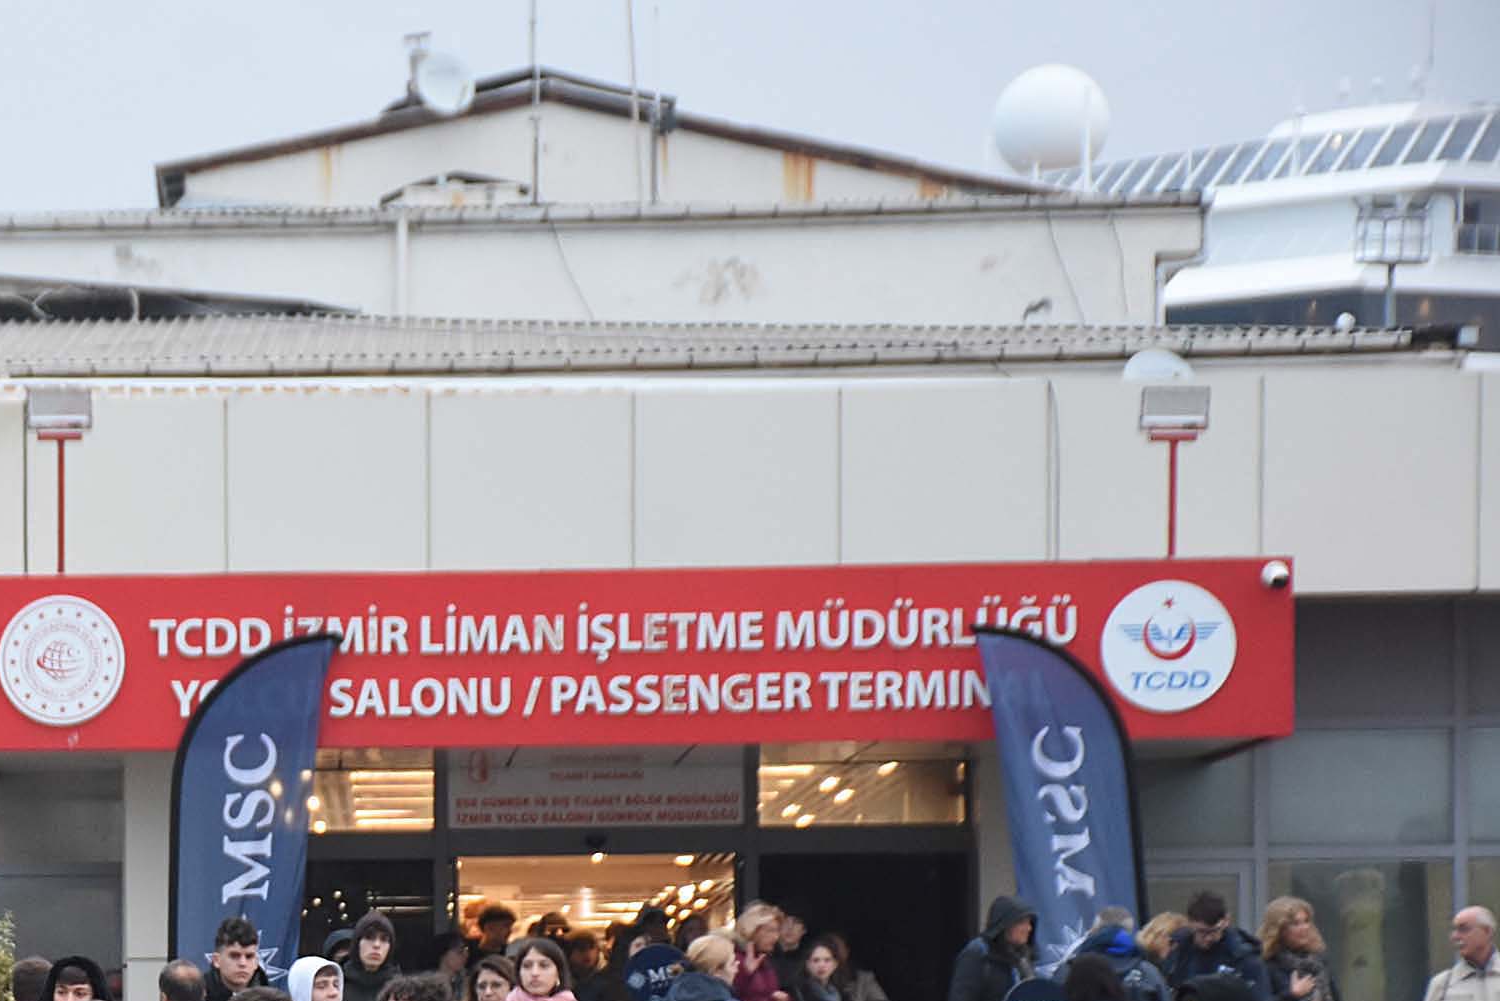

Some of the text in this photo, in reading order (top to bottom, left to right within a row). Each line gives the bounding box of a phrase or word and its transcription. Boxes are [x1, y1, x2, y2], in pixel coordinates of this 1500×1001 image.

[149, 617, 272, 657] TCDD
[420, 602, 565, 654] LİMAN
[576, 601, 765, 663] İŞLETME
[329, 676, 512, 717] SALONU
[550, 672, 813, 715] PASSENGER
[818, 670, 993, 712] TERMIN
[1131, 670, 1212, 690] TCDD
[222, 733, 277, 904] MSC
